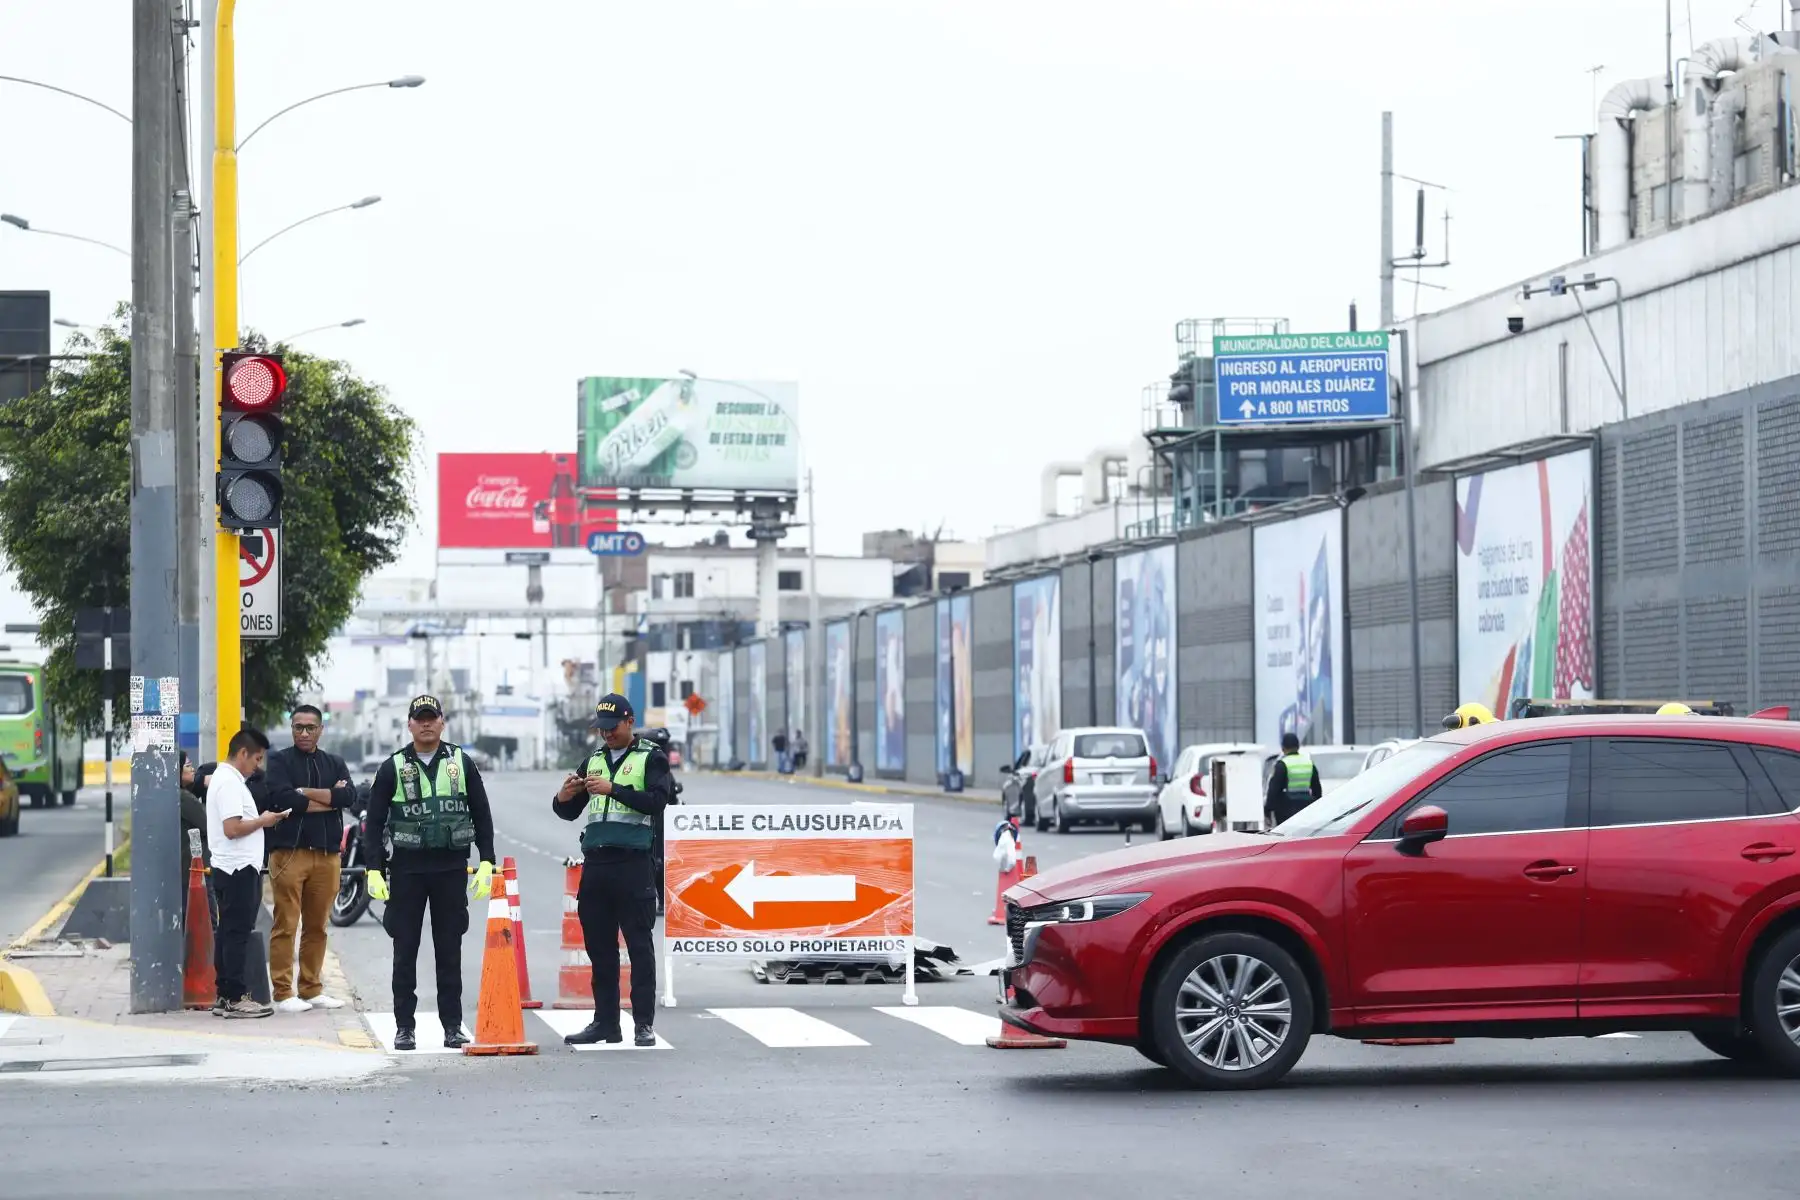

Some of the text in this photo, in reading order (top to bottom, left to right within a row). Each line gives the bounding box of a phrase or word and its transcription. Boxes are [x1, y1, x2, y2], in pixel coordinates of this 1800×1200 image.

[1219, 334, 1383, 352] MUNICIPALIDAD DEL CALLAO
[1220, 357, 1384, 376] INGRESO AL AEROPUERTO
[1230, 375, 1376, 396] POR MORALES DUÁREZ
[1258, 398, 1349, 415] A 800 METROS
[242, 592, 254, 608] O
[240, 614, 273, 631] ONES
[412, 698, 438, 711] POLICIA
[146, 721, 174, 730] TERRENO
[673, 814, 904, 832] CALLE CLAUSURADA
[672, 939, 906, 954] ACCESO SOLO PROPIETARIOS
